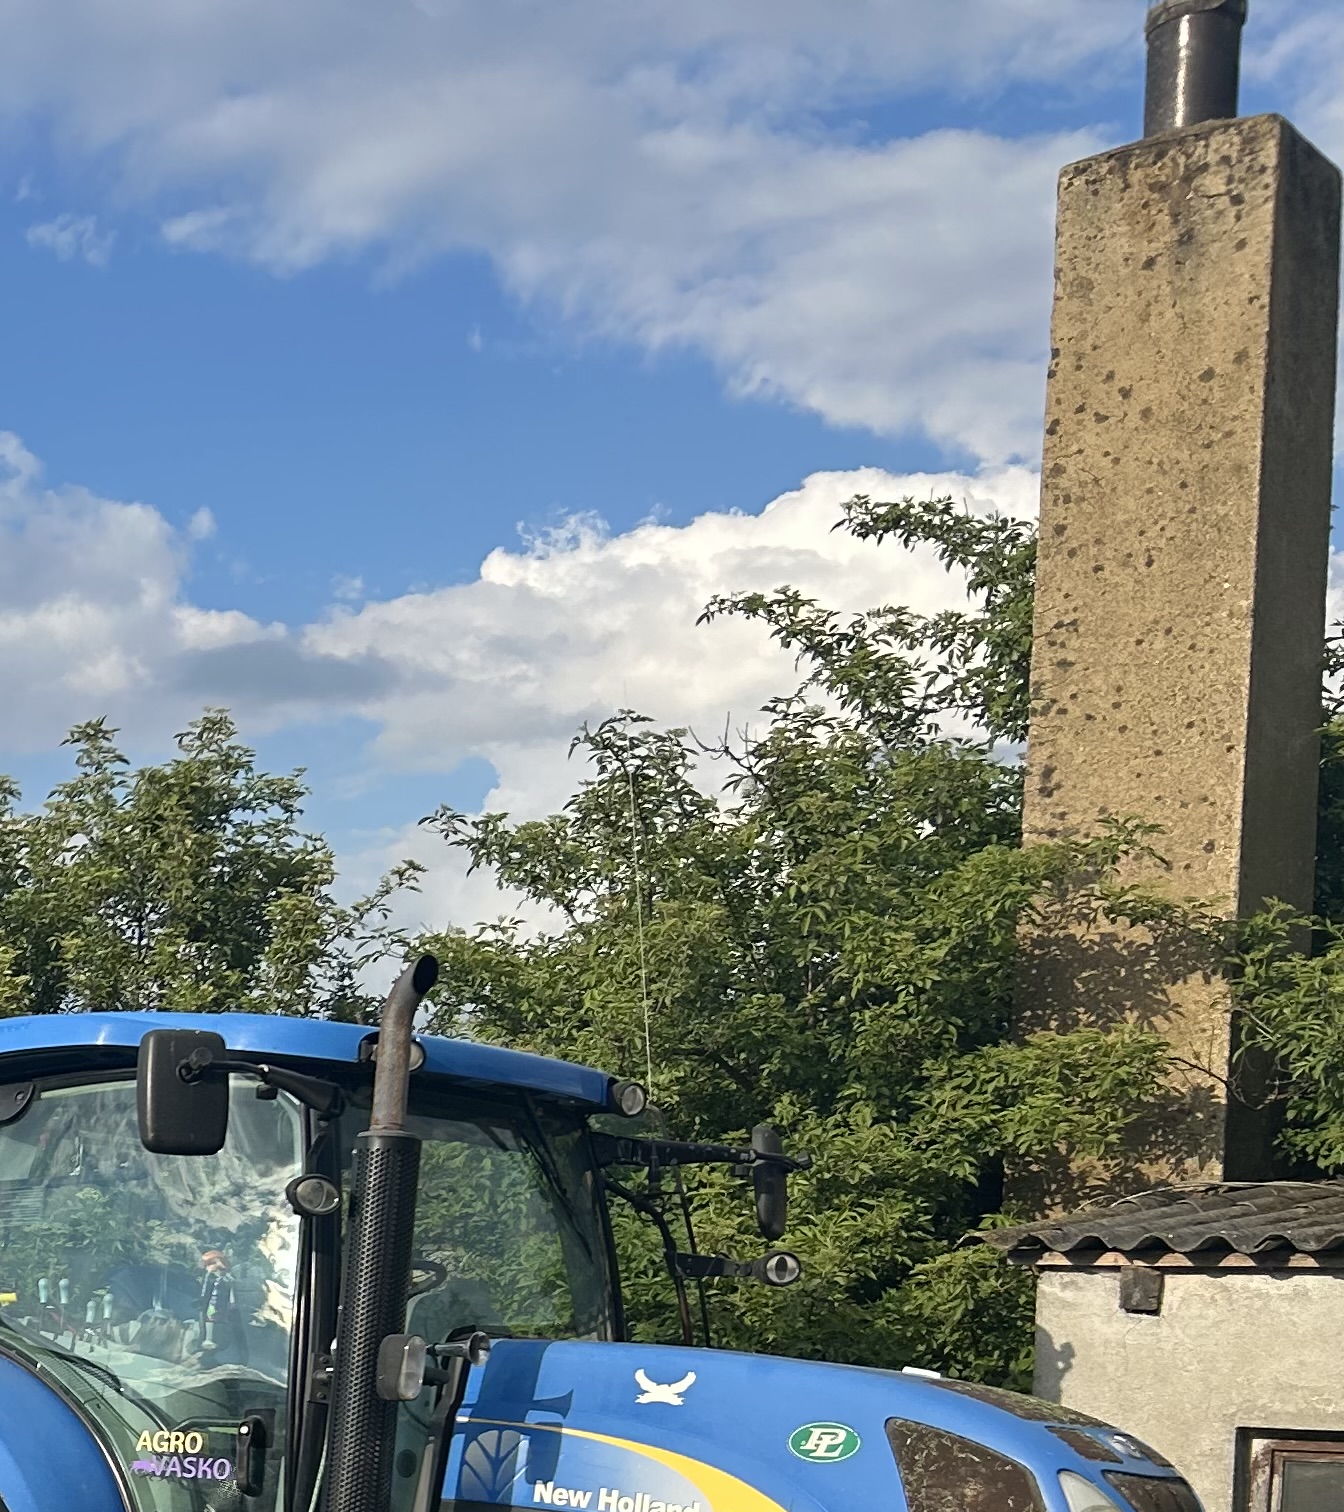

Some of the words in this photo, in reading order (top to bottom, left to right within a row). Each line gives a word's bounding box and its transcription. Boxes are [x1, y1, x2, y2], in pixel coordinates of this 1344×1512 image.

[136, 1430, 203, 1454] AGRO
[152, 1455, 232, 1480] VASKO
[533, 1480, 593, 1508] New
